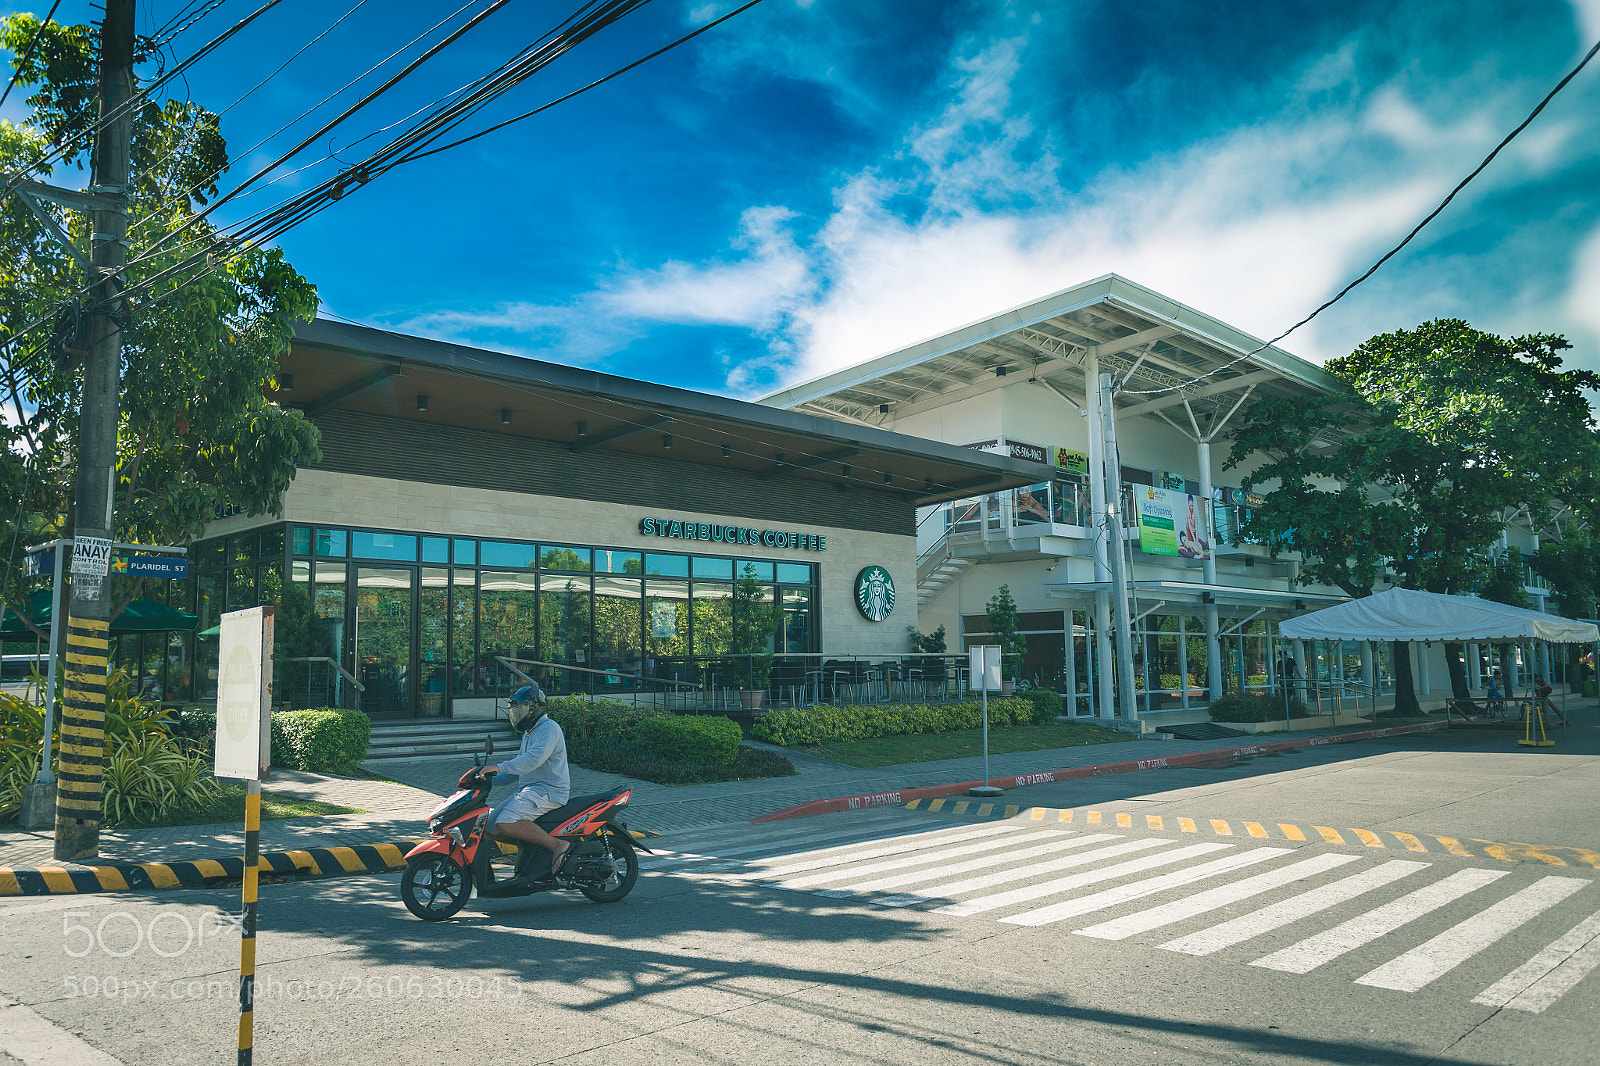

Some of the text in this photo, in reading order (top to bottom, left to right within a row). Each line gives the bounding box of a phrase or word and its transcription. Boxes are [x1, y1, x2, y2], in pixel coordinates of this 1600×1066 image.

[640, 517, 827, 551] STARBUCKS COFFEE
[73, 556, 107, 566] CONTROL
[131, 563, 170, 571] PLARIDEL
[1015, 773, 1055, 786] NO PARKING
[848, 792, 902, 809] NO PARKING
